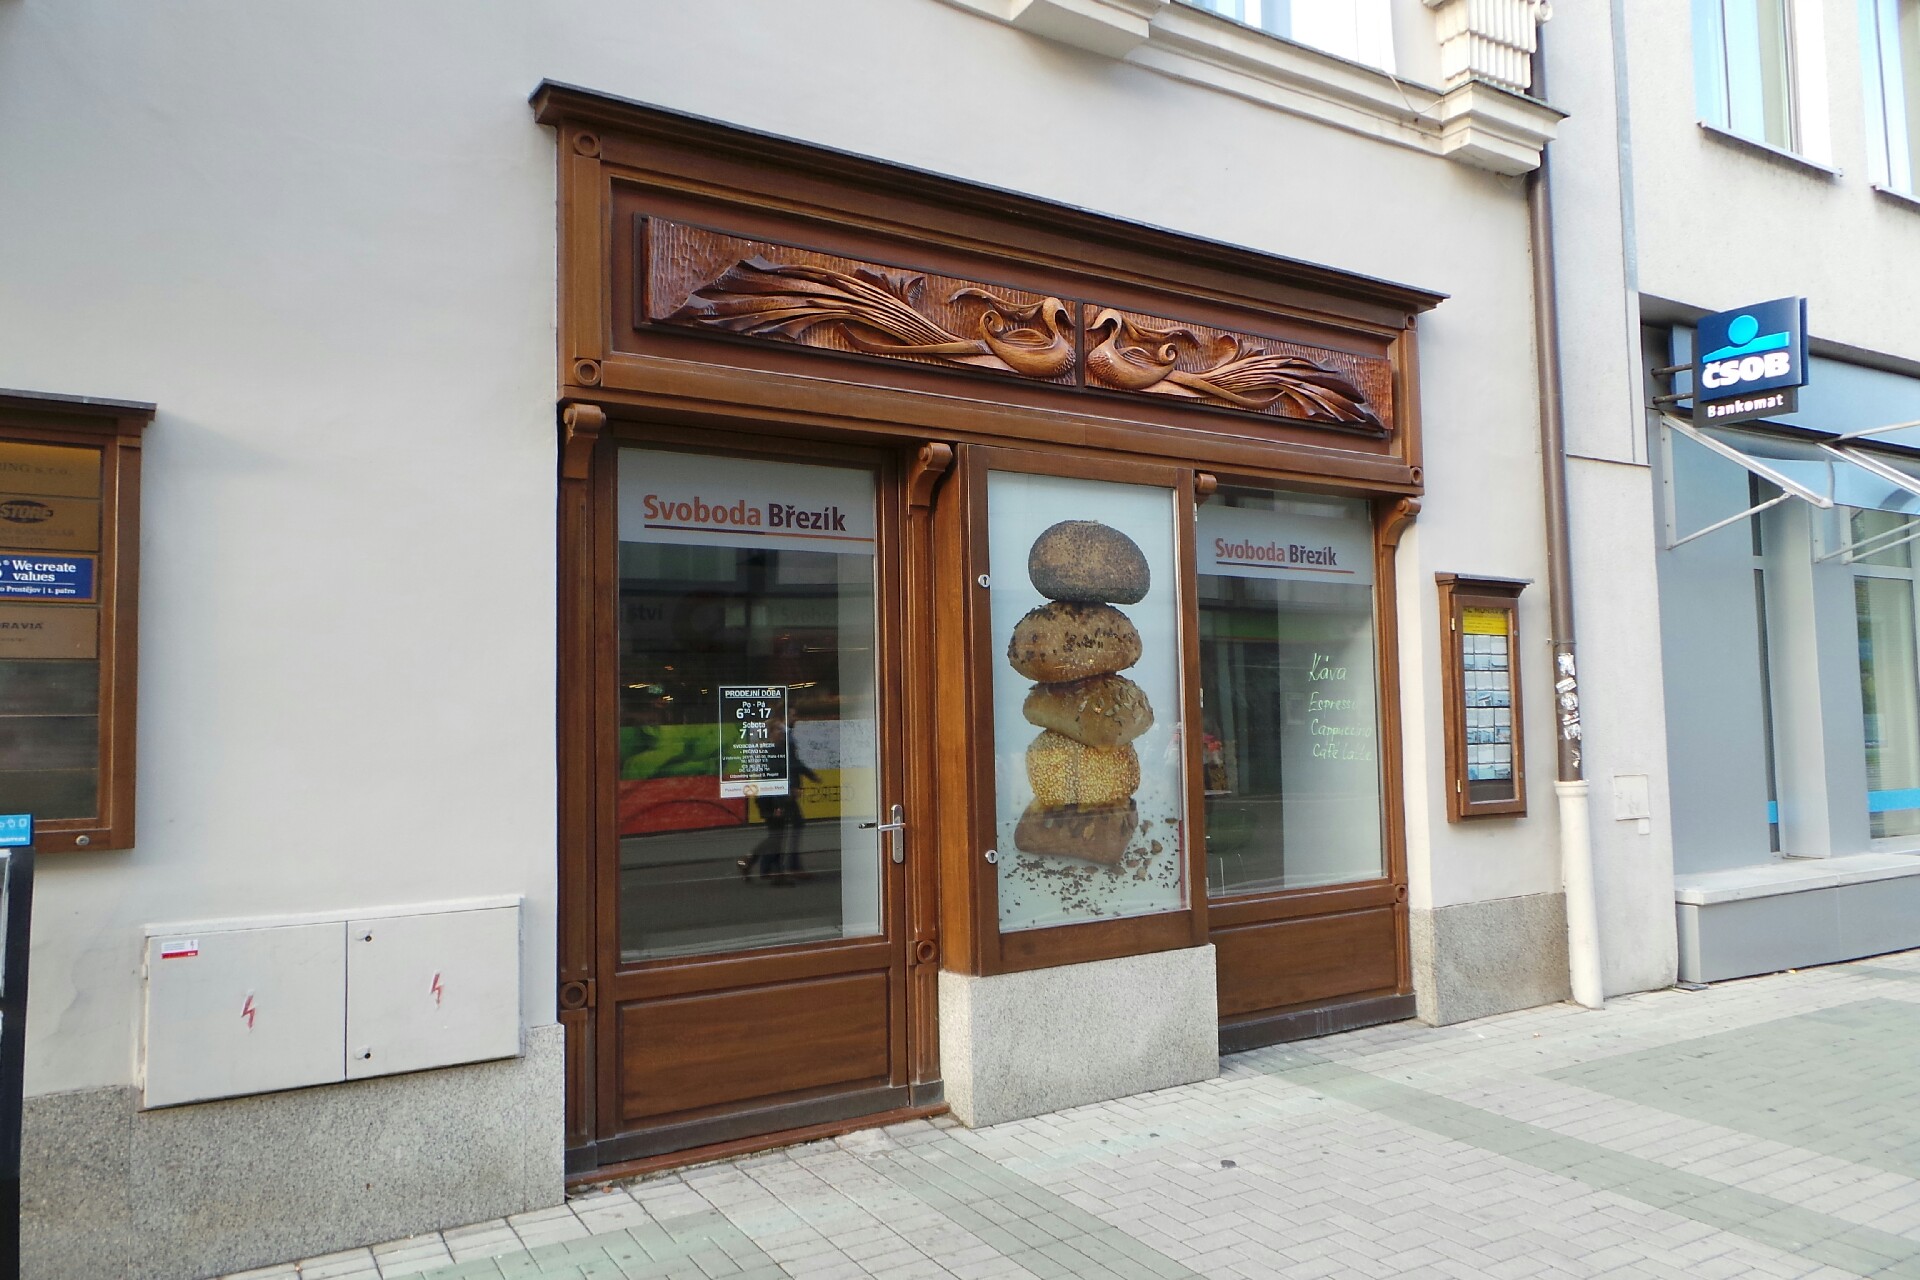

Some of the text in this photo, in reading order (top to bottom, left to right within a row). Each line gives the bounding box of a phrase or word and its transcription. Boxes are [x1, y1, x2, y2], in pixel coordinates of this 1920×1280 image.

[1702, 352, 1790, 389] ČSOB
[1707, 394, 1784, 418] Bankomat
[643, 494, 846, 531] Svoboda Březík
[1215, 537, 1338, 566] Svoboda Březík
[12, 560, 77, 573] We create
[12, 571, 55, 582] values
[0, 622, 43, 630] RAVIA
[1308, 653, 1347, 682] Káva
[725, 689, 781, 697] PRODEJNÍ DOBA
[758, 708, 771, 719] 17
[742, 721, 766, 729] Sobota
[739, 728, 747, 739] 7
[757, 728, 768, 739] 11
